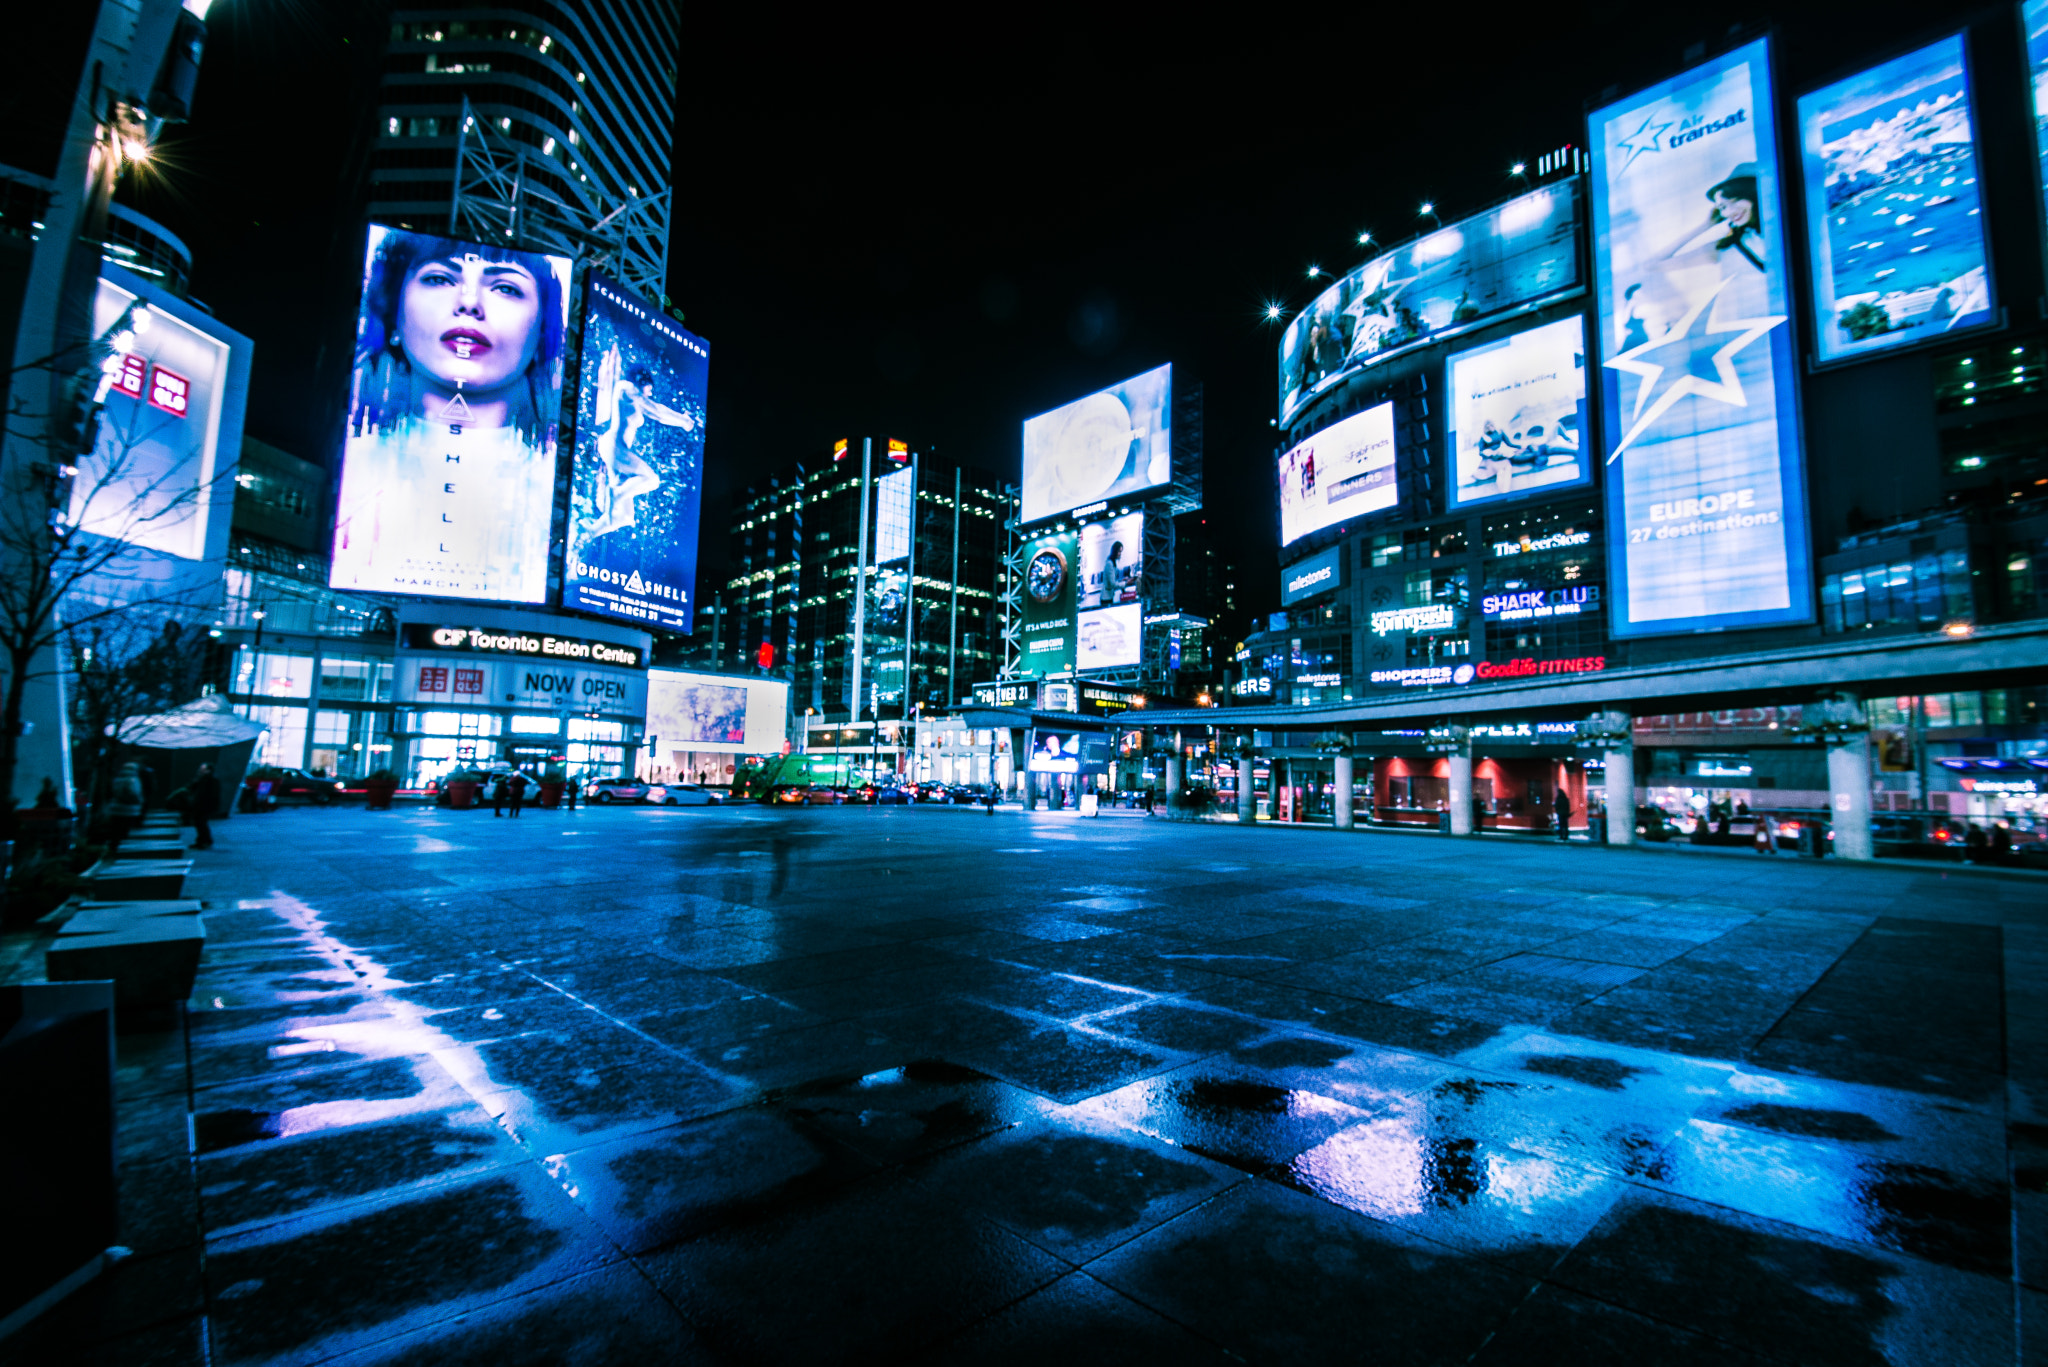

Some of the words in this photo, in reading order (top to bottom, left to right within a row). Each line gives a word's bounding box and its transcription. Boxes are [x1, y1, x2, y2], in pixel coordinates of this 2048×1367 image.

[1669, 108, 1747, 148] transat
[439, 423, 463, 553] SHELL
[1330, 470, 1383, 498] WINNERS
[1650, 488, 1755, 522] EUROPE
[1630, 527, 1652, 543] 27
[1655, 511, 1780, 540] destinations
[1493, 541, 1521, 557] The
[1551, 532, 1591, 548] Store
[577, 562, 629, 586] GHOST
[644, 580, 688, 603] SHELL
[610, 601, 647, 618] MARCH
[647, 610, 658, 621] 31
[1482, 590, 1546, 614] SHARK
[1549, 585, 1599, 604] CLUB
[432, 628, 467, 646] CF
[468, 630, 540, 652] Toronto
[542, 637, 590, 658] Eaton
[591, 643, 637, 665] Centre
[1297, 673, 1341, 683] milestones
[1371, 666, 1453, 682] SHOPPERS
[1476, 657, 1538, 678] GoodLife
[1538, 656, 1606, 674] FITNESS
[525, 673, 575, 695] NOW
[581, 677, 626, 699] OPEN
[1018, 685, 1028, 700] 21
[1537, 722, 1577, 734] IMAX
